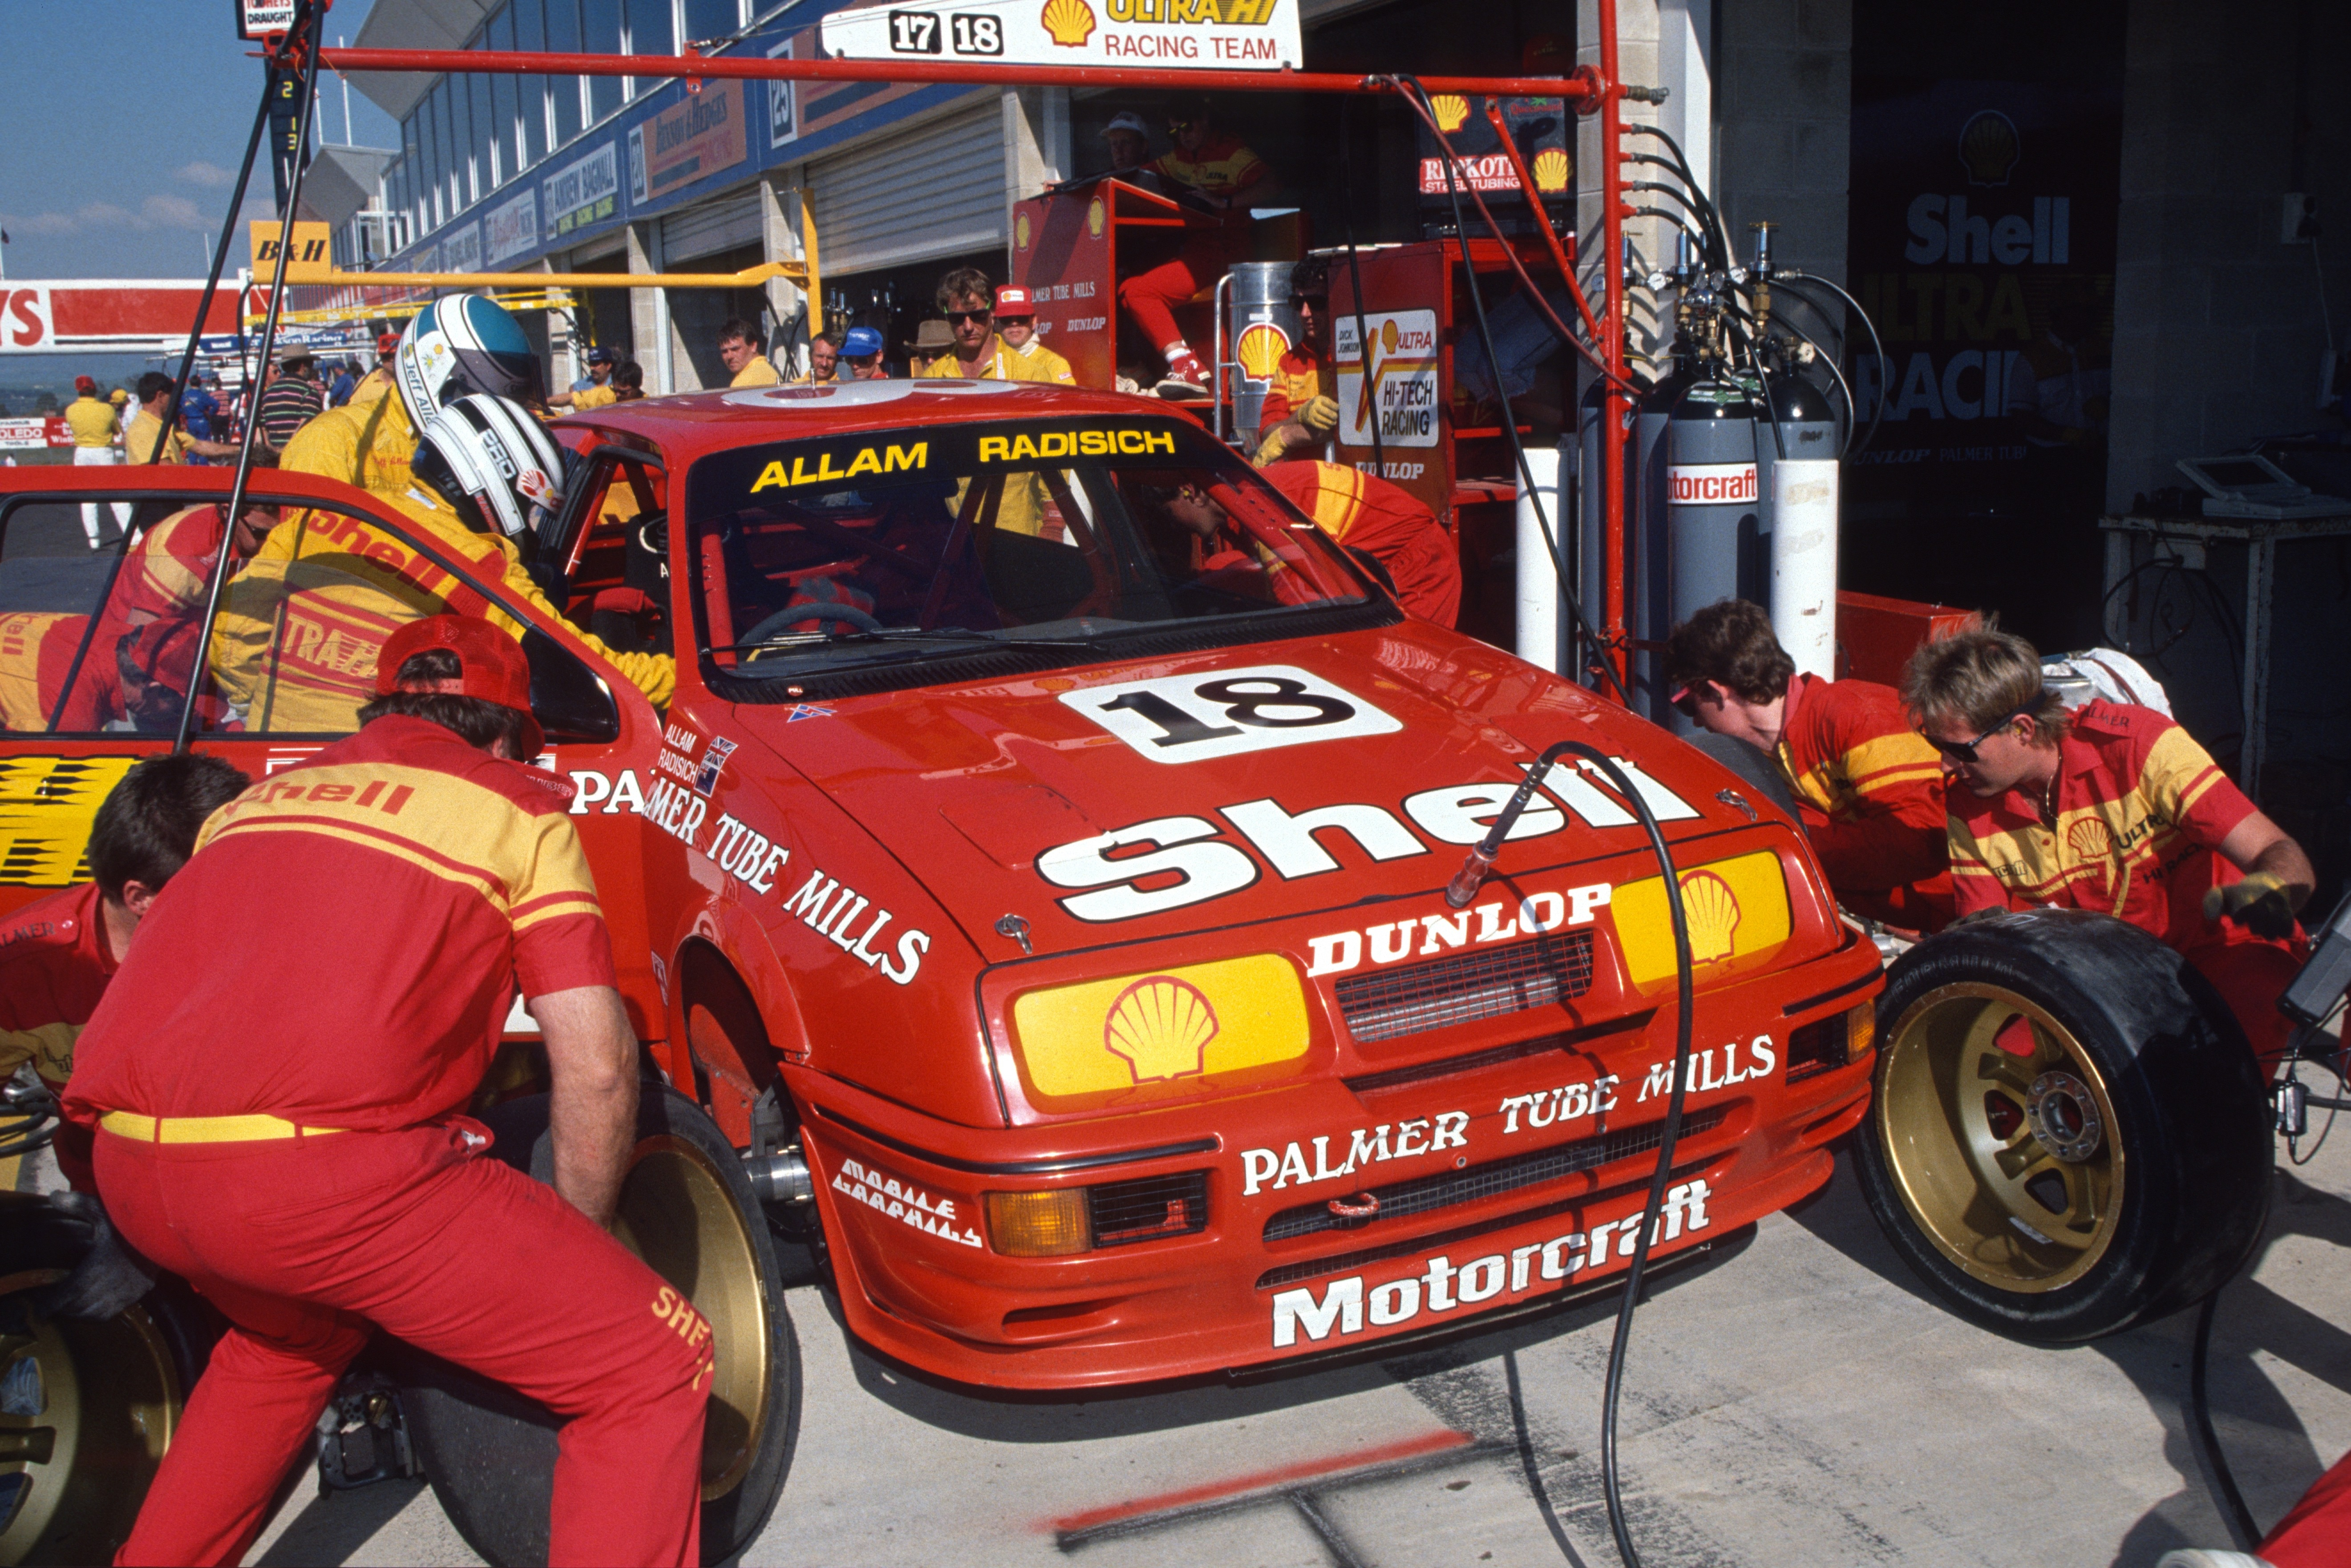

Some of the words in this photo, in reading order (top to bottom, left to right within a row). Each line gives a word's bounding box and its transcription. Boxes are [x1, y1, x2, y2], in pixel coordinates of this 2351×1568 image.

[248, 12, 292, 24] DRAUGHT
[1106, 0, 1222, 23] ULTRA
[894, 15, 935, 50] 17
[955, 17, 999, 52] 18
[1105, 34, 1198, 58] RACING
[1210, 37, 1276, 59] TEAM
[282, 81, 293, 98] 2
[1470, 178, 1521, 189] TUBING
[1904, 193, 2070, 265] Shell
[1032, 287, 1051, 303] LMER
[1053, 285, 1070, 299] TUBE
[1073, 281, 1095, 299] MILLS
[1034, 322, 1052, 335] LOP
[1067, 316, 1106, 332] DUNLOP
[1339, 329, 1353, 340] DICK
[1338, 341, 1360, 354] JOHNSON
[1397, 331, 1432, 350] ULTRA
[1383, 380, 1433, 406] HI-TECH
[1382, 410, 1430, 436] RACING
[750, 442, 929, 493] ALLAM
[979, 431, 1175, 462] RADISICH
[1939, 446, 1993, 462] PALMER
[1097, 677, 1356, 748] 18
[664, 723, 697, 753] ALLAM
[657, 748, 699, 784] RADISICH
[224, 780, 415, 817] Shell
[1035, 755, 1703, 923] Shell
[706, 812, 790, 895] TUBE
[782, 869, 931, 985] MILLS
[1306, 883, 1613, 978] DUNLOP
[1240, 1110, 1470, 1196] PALMER
[1498, 1074, 1620, 1134] TUBE
[1636, 1034, 1777, 1103] MILLS
[841, 1158, 956, 1220] MOBILE
[1271, 1178, 1713, 1350] Motorcraft
